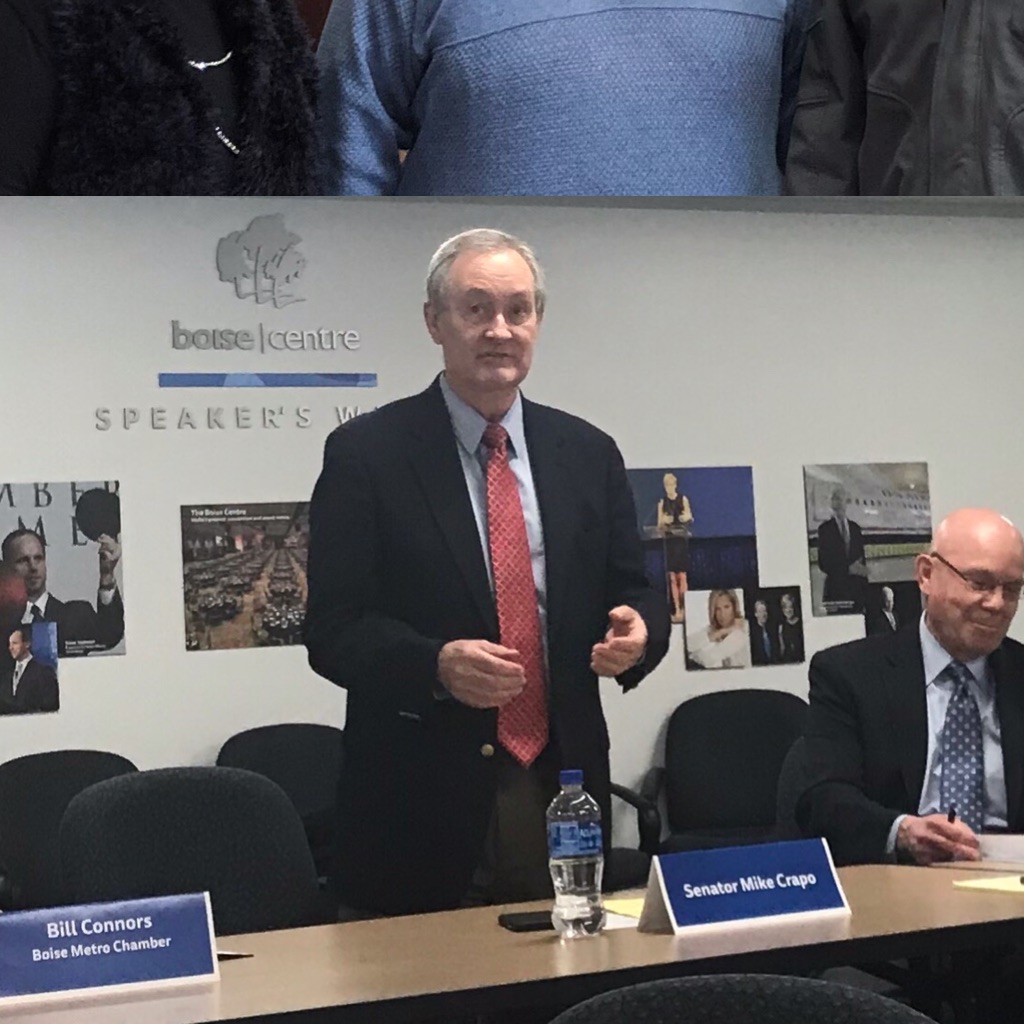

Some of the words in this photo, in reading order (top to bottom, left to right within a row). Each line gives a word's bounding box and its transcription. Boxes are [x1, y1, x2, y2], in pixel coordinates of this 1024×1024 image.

[94, 406, 313, 431] SPEAKER'S
[683, 882, 738, 899] Senator
[740, 876, 775, 892] Mike
[776, 872, 817, 890] Crapo
[47, 920, 77, 938] Bill
[81, 915, 153, 936] Connors
[32, 947, 68, 961] Boise
[71, 943, 110, 958] Metro
[113, 936, 172, 953] Chamber
